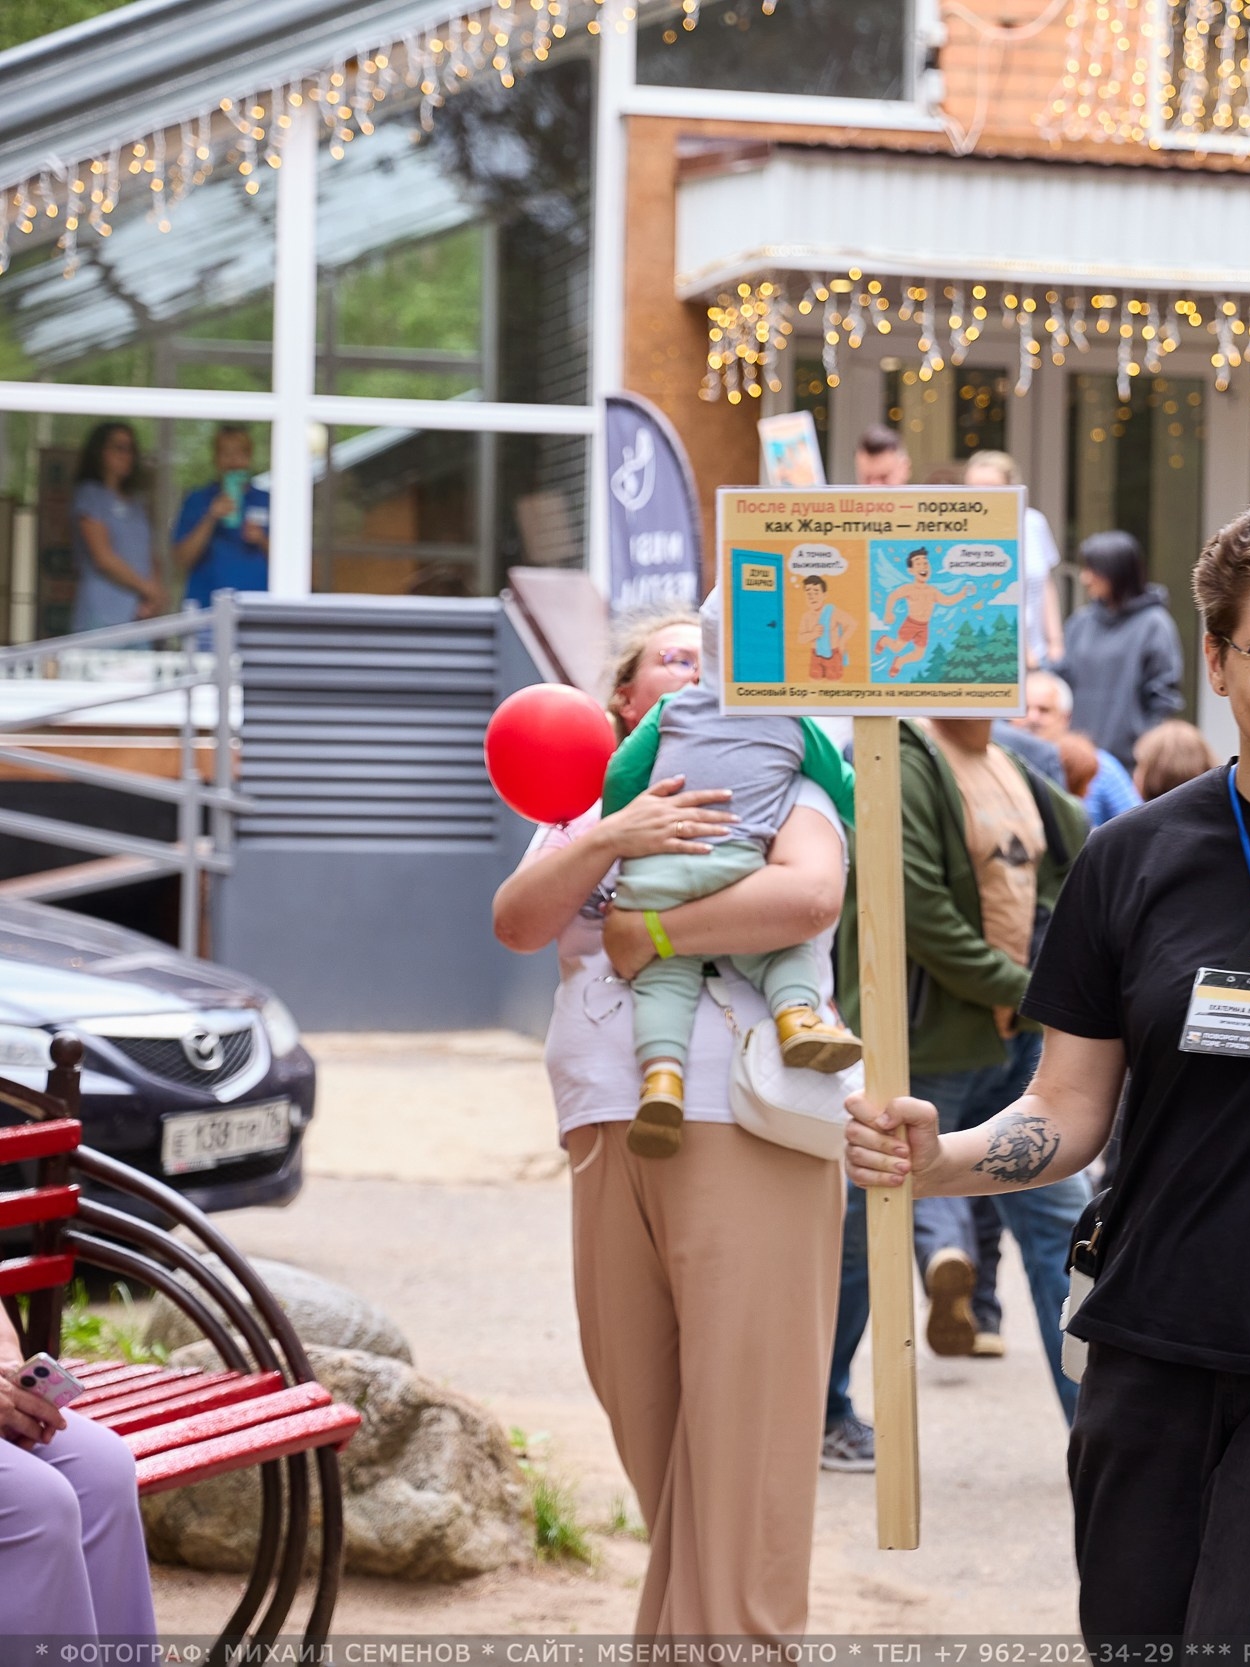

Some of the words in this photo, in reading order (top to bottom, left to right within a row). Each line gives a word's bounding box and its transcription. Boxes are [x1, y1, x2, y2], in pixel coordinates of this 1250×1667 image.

[736, 499, 787, 513] После
[790, 502, 835, 517] душа
[840, 499, 895, 517] Шарко
[917, 500, 988, 517] порхаю,
[765, 521, 793, 533] как
[798, 518, 892, 535] Жар-птица
[916, 518, 968, 533] легко!
[750, 568, 769, 577] ДУШ
[745, 578, 774, 587] ШАРКО
[737, 687, 786, 697] Сосновый
[790, 687, 807, 698] Бор
[818, 689, 882, 699] перезагрузка
[899, 688, 961, 697] максимальной
[966, 689, 1011, 699] мощности!
